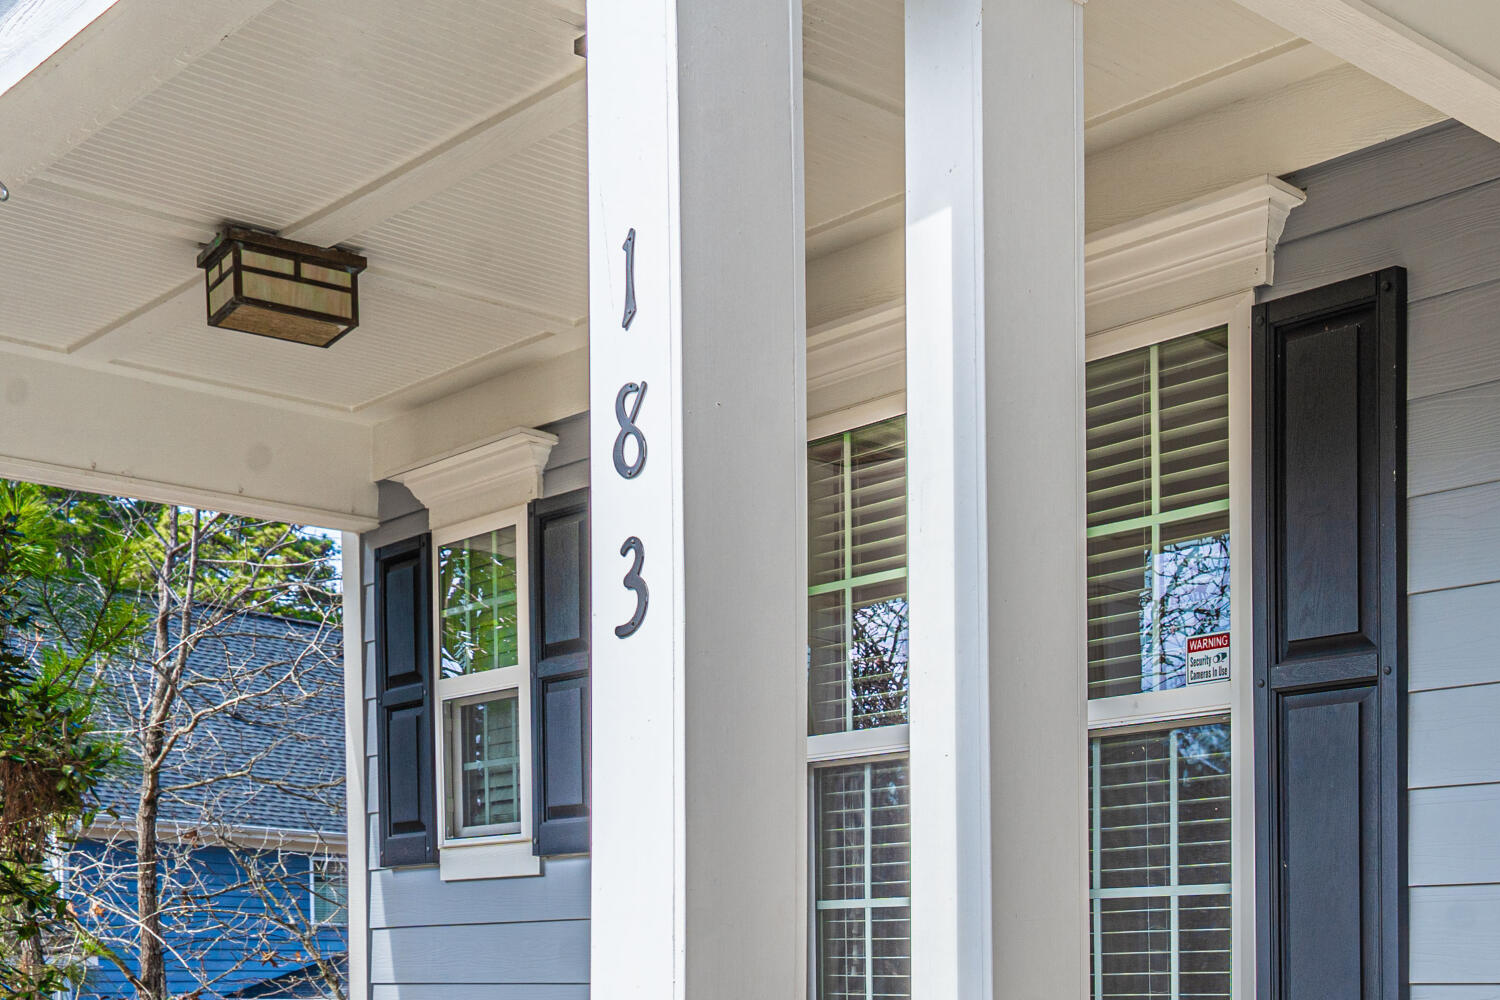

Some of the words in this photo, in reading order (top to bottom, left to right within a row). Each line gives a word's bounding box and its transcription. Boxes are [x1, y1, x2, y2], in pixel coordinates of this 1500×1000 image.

[612, 227, 649, 640] 183
[1189, 635, 1228, 651] WARNING
[1190, 655, 1212, 667] Security
[1190, 670, 1211, 681] Cameras
[1212, 667, 1217, 677] In
[1218, 666, 1228, 676] Use
